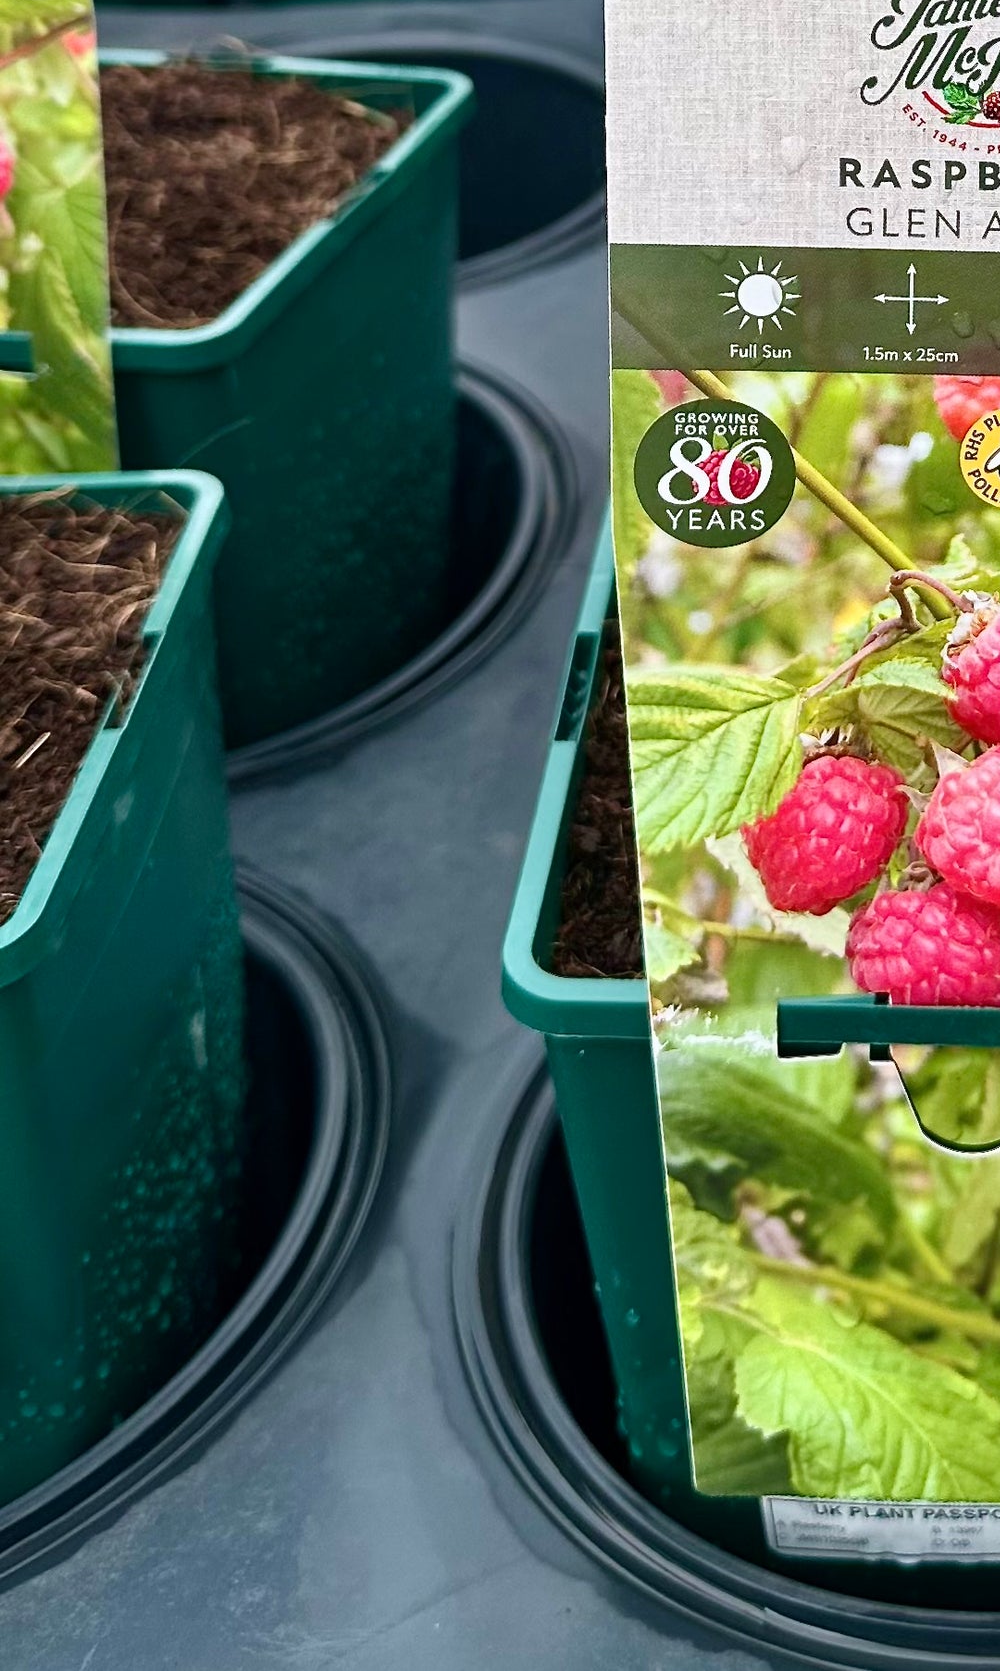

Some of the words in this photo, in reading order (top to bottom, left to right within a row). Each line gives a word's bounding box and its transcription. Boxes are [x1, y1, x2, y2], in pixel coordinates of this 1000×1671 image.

[932, 129, 967, 152] 1944
[845, 206, 962, 240] GLEN
[729, 343, 760, 360] Full
[762, 344, 793, 361] Sun
[863, 346, 898, 363] 1.5m
[915, 347, 959, 363] 25cm
[674, 412, 759, 425] GROWING
[675, 424, 707, 436] FOR
[714, 424, 759, 437] OVER
[964, 425, 985, 462] RHS
[657, 436, 773, 505] 80
[666, 509, 766, 531] YEARS
[814, 1503, 842, 1517] UK
[850, 1505, 916, 1520] PLANT
